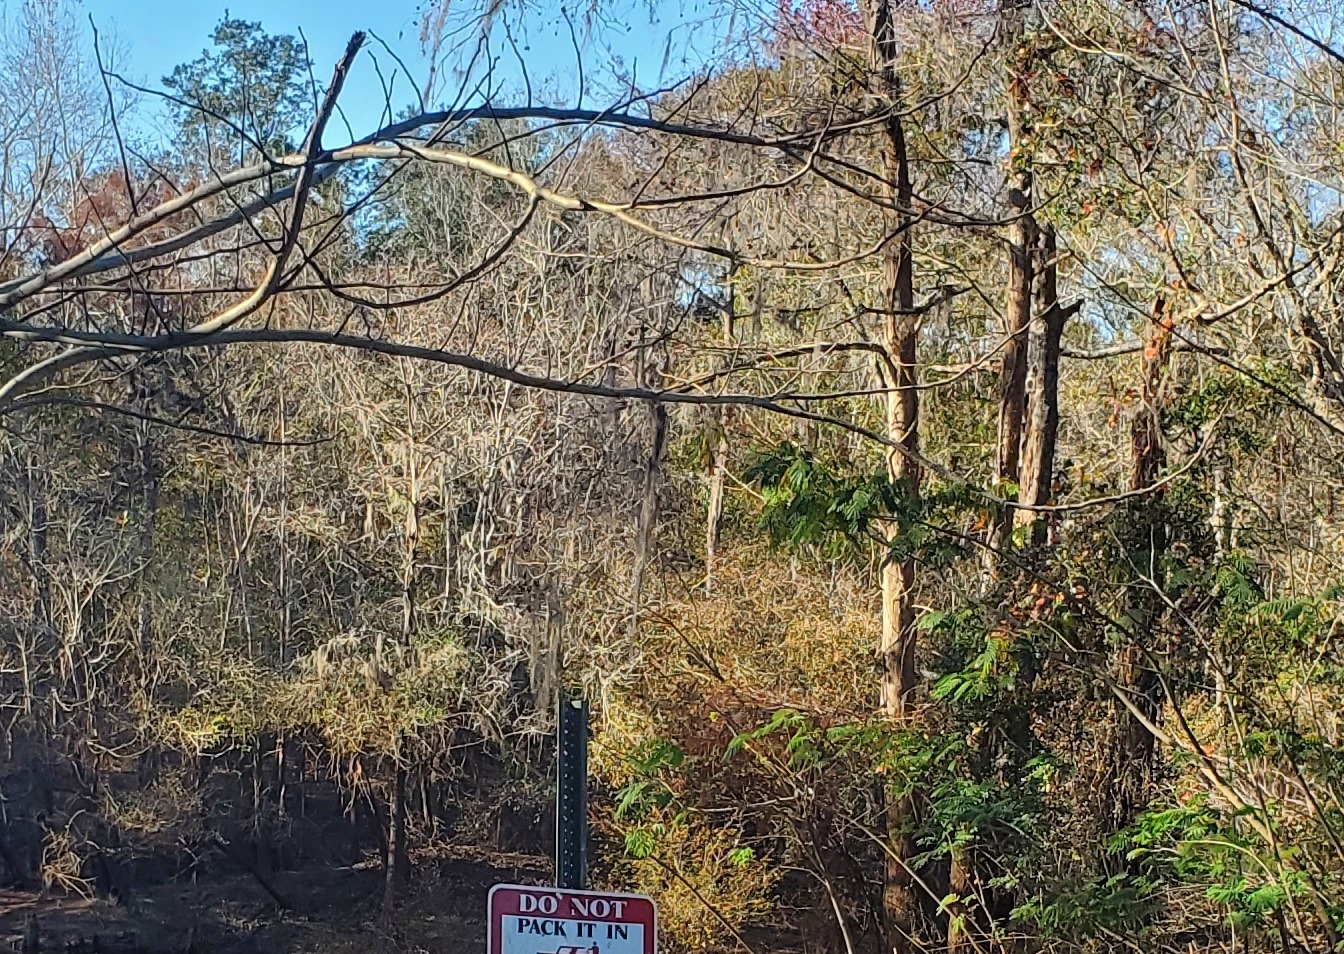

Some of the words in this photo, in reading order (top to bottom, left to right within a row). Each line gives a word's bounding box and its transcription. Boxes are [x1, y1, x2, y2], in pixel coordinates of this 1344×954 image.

[519, 893, 558, 914] DO
[571, 897, 628, 919] NOT
[517, 918, 566, 937] PACK
[577, 922, 597, 938] IT
[607, 924, 628, 940] IN
